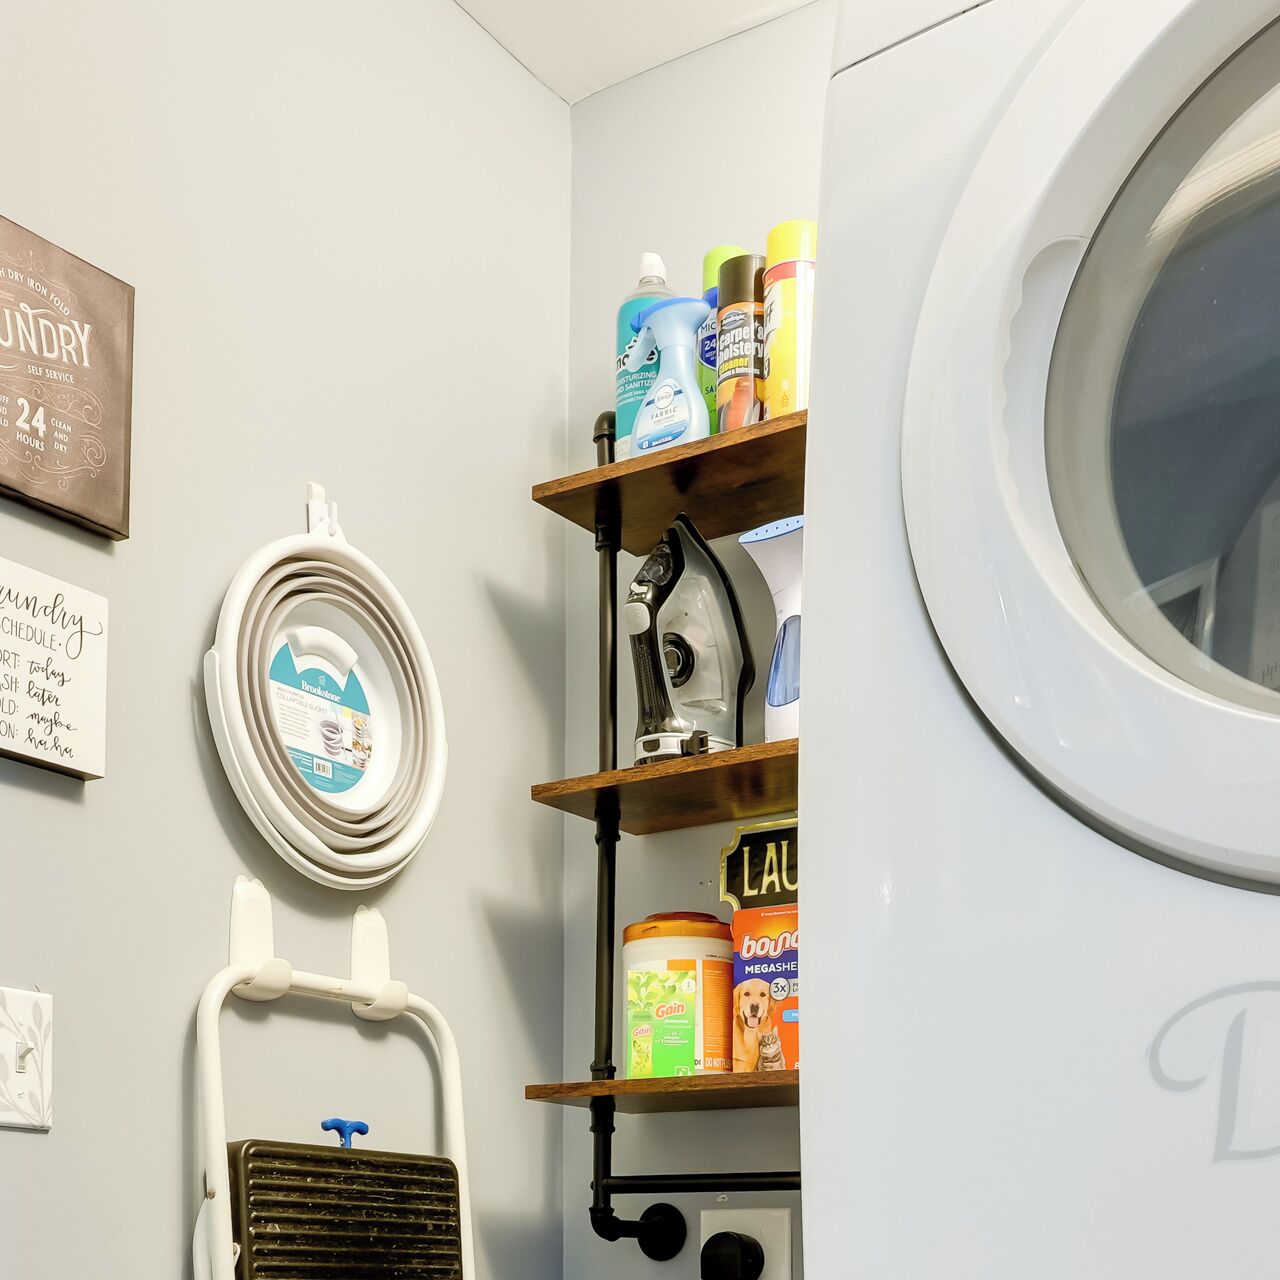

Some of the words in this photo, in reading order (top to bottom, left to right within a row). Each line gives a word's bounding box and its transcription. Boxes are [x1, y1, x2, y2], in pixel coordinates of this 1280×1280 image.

[8, 269, 24, 283] DRY
[27, 276, 47, 297] IRON
[49, 293, 69, 316] FOLD
[27, 365, 43, 376] SELF
[45, 369, 74, 383] SERVICE
[16, 398, 46, 438] 24
[50, 418, 72, 432] CLEAN
[16, 431, 45, 451] HOURS
[54, 431, 68, 443] AND
[54, 442, 68, 453] DRY
[27, 657, 71, 687] today
[26, 681, 60, 706] later
[301, 681, 340, 702] Brookstone
[26, 712, 77, 736] maybe
[655, 1003, 685, 1019] Gain
[633, 1026, 652, 1037] Gain
